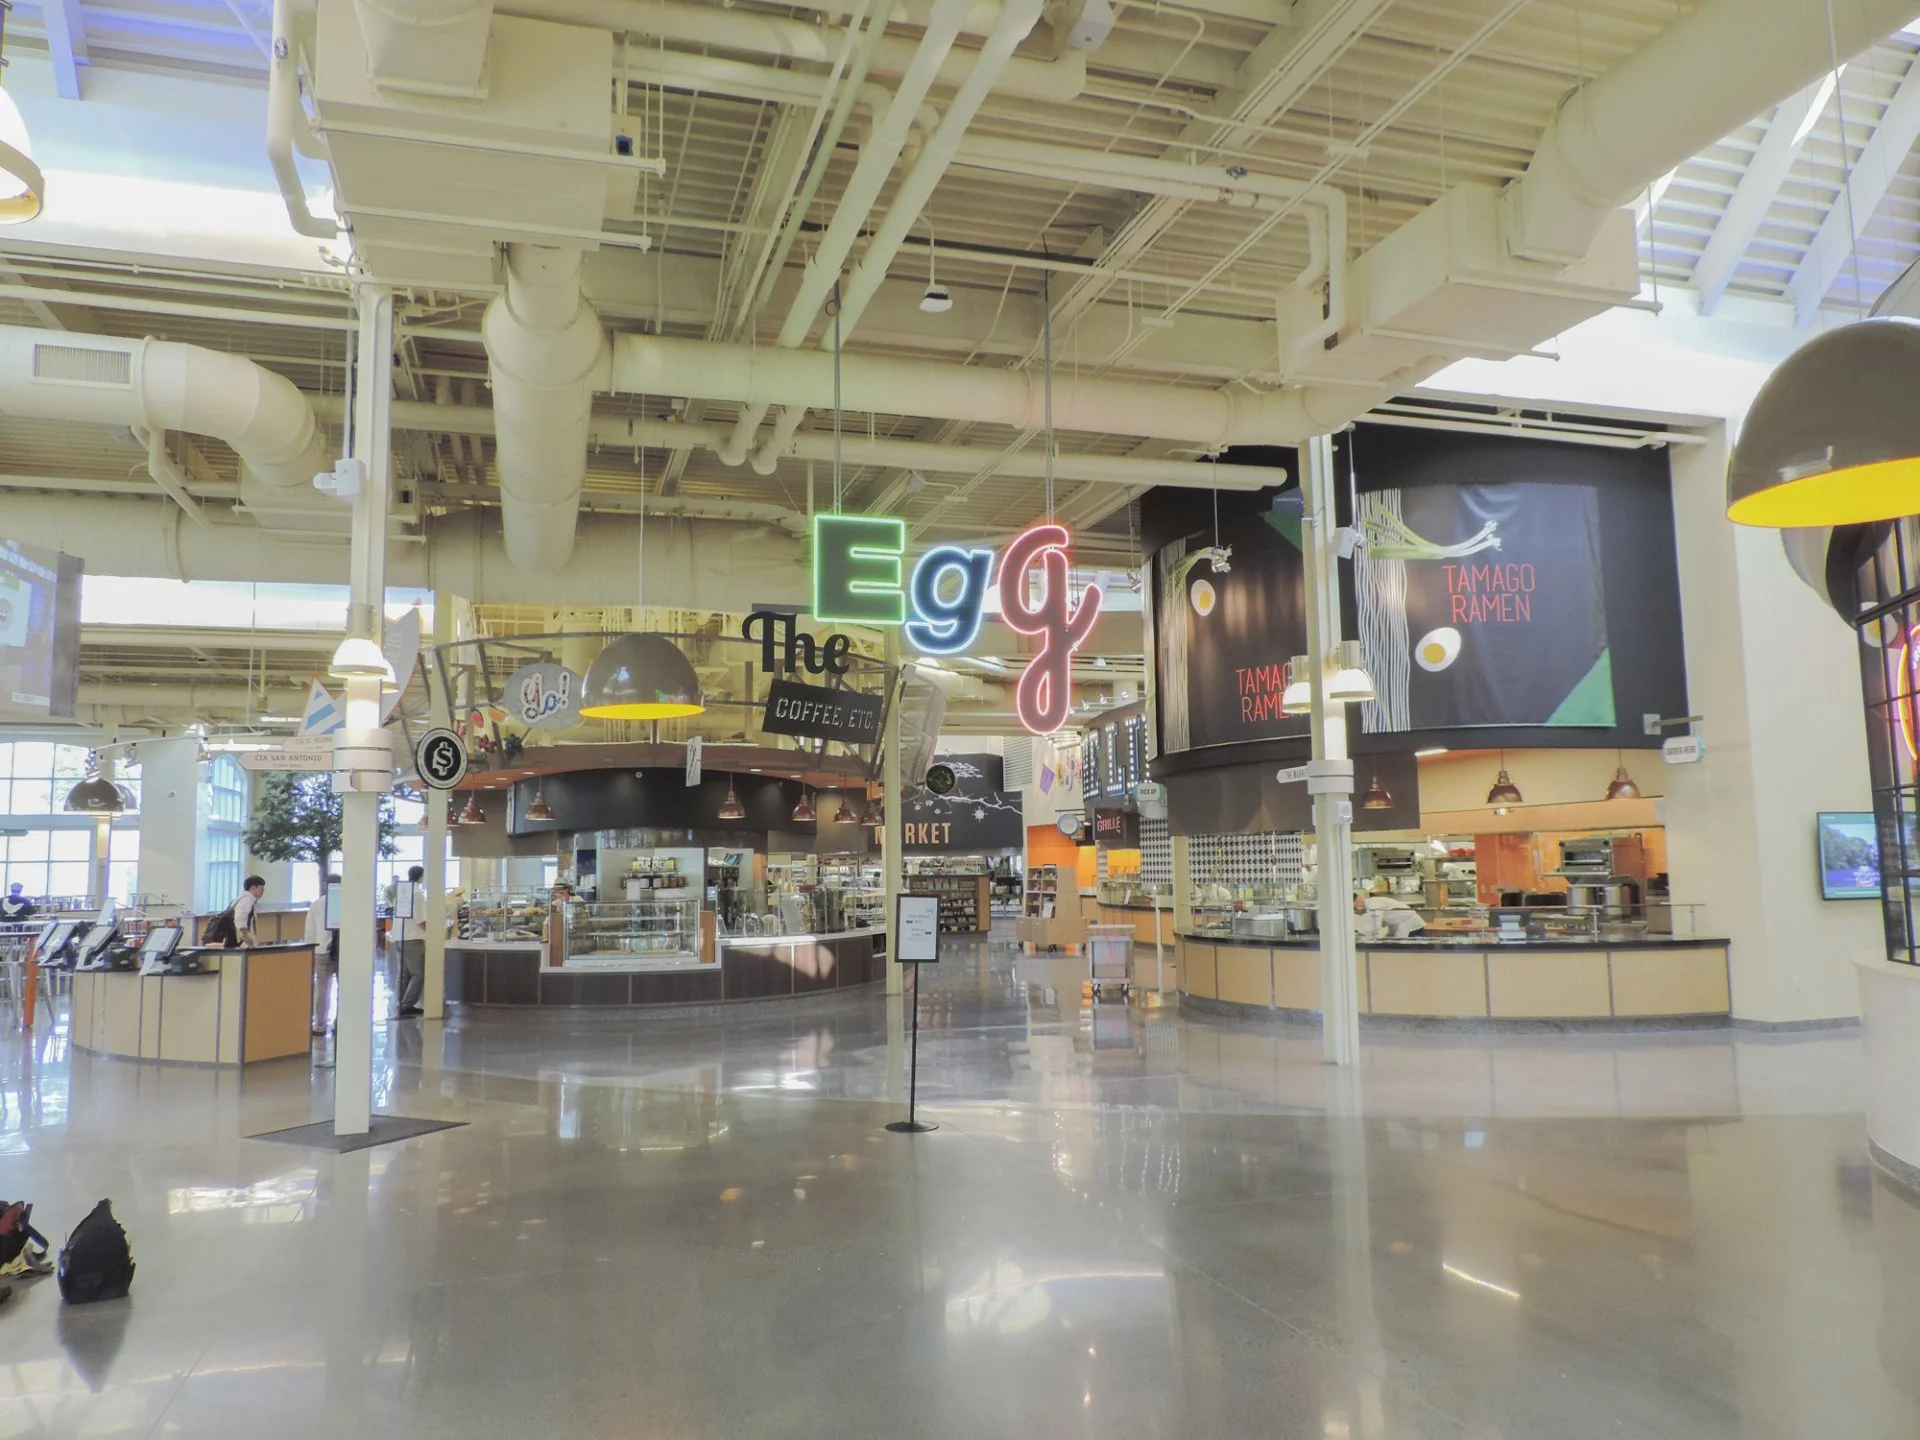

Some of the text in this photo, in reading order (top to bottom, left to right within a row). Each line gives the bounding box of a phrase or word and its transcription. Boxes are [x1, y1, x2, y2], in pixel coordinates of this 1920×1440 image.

[1441, 563, 1536, 593] TAMAGO
[1452, 593, 1531, 623] RAMEN
[813, 514, 1104, 736] Egg
[741, 611, 850, 675] The
[775, 697, 874, 731] COFFEE, ETC.
[1242, 691, 1290, 723] RAME
[874, 822, 952, 845] MRKET
[1096, 817, 1121, 832] GRILLE
